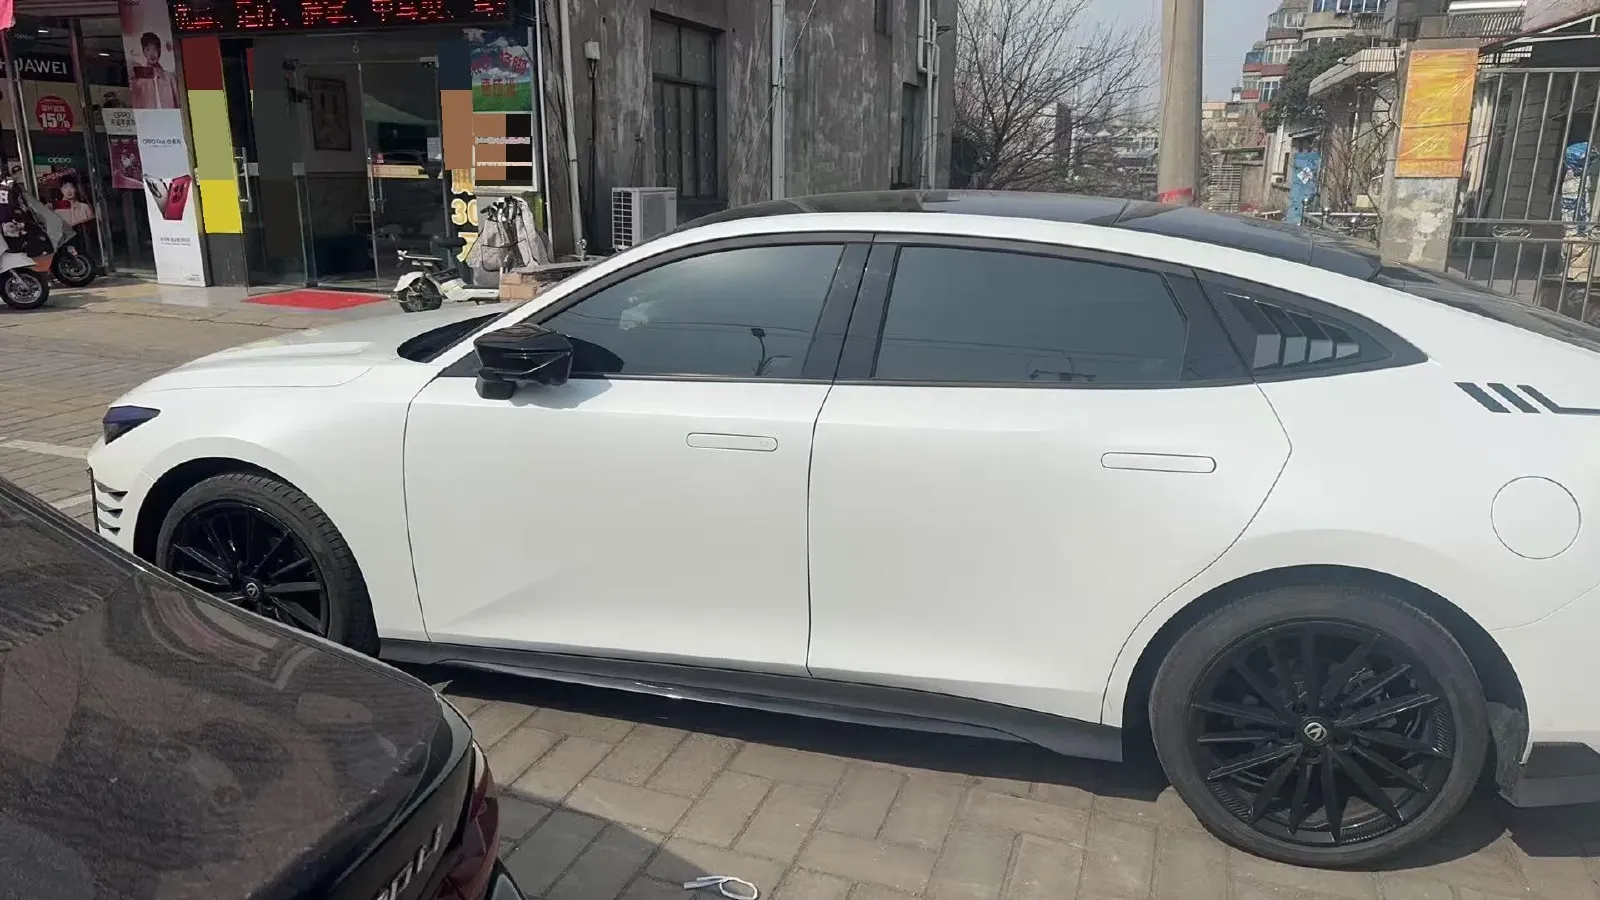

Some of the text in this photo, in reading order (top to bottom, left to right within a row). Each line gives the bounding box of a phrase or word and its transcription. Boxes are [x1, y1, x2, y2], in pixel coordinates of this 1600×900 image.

[113, 111, 130, 119] OPPO
[39, 112, 70, 129] 15%
[47, 156, 72, 164] oppo
